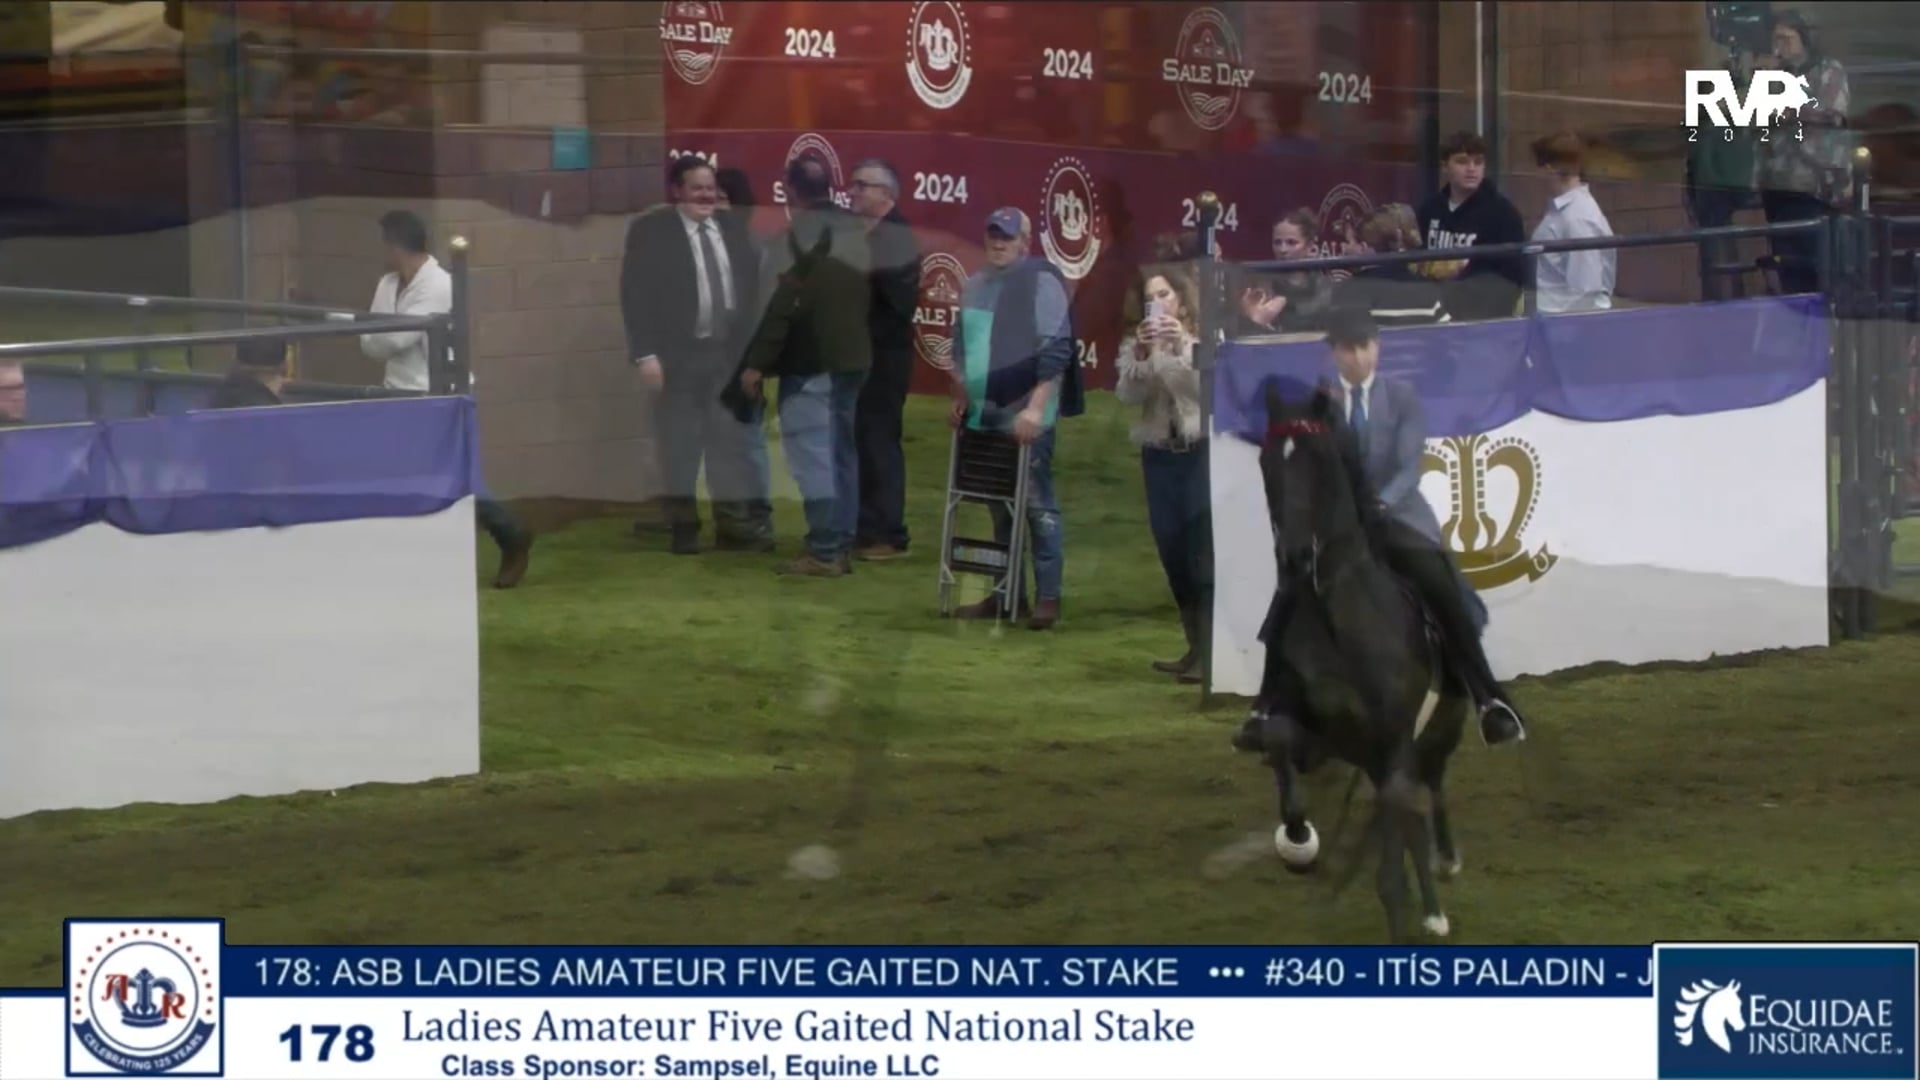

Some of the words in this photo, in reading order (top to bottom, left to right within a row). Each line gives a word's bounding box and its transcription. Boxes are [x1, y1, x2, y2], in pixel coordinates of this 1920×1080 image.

[785, 27, 836, 59] 2024
[1043, 47, 1093, 80] 2024
[1319, 71, 1372, 104] 2024
[913, 170, 969, 204] 2024
[1182, 197, 1239, 232] 224
[911, 306, 946, 326] ALE
[1076, 338, 1098, 369] 24
